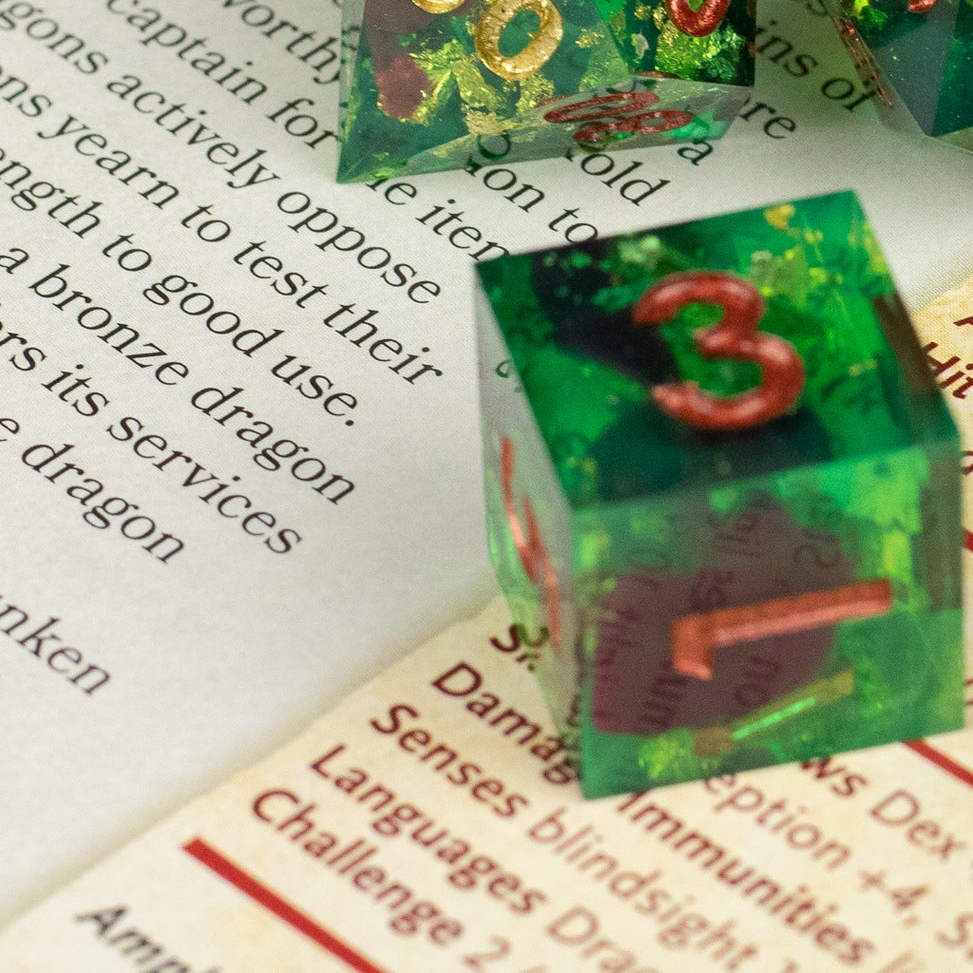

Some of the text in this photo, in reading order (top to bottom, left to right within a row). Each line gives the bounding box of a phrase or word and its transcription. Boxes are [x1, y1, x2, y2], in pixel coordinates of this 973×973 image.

[105, 74, 281, 190] actively
[277, 189, 442, 305] oppose
[267, 97, 343, 151] for
[676, 136, 715, 167] a
[0, 67, 443, 386] ns yearn to test their
[0, 147, 359, 428] ngth to good use.
[547, 207, 600, 240] to
[0, 247, 357, 506] a bronze dragon
[631, 267, 808, 431] 3
[0, 321, 304, 556] rs its services
[20, 442, 186, 565] dragon
[0, 593, 113, 696] nken
[251, 787, 467, 949] Challenge
[309, 741, 549, 916] Languages
[369, 701, 761, 973] Senses blindsight
[615, 788, 878, 966] Immunities
[856, 866, 931, 929] +4,
[867, 788, 968, 864] Dex
